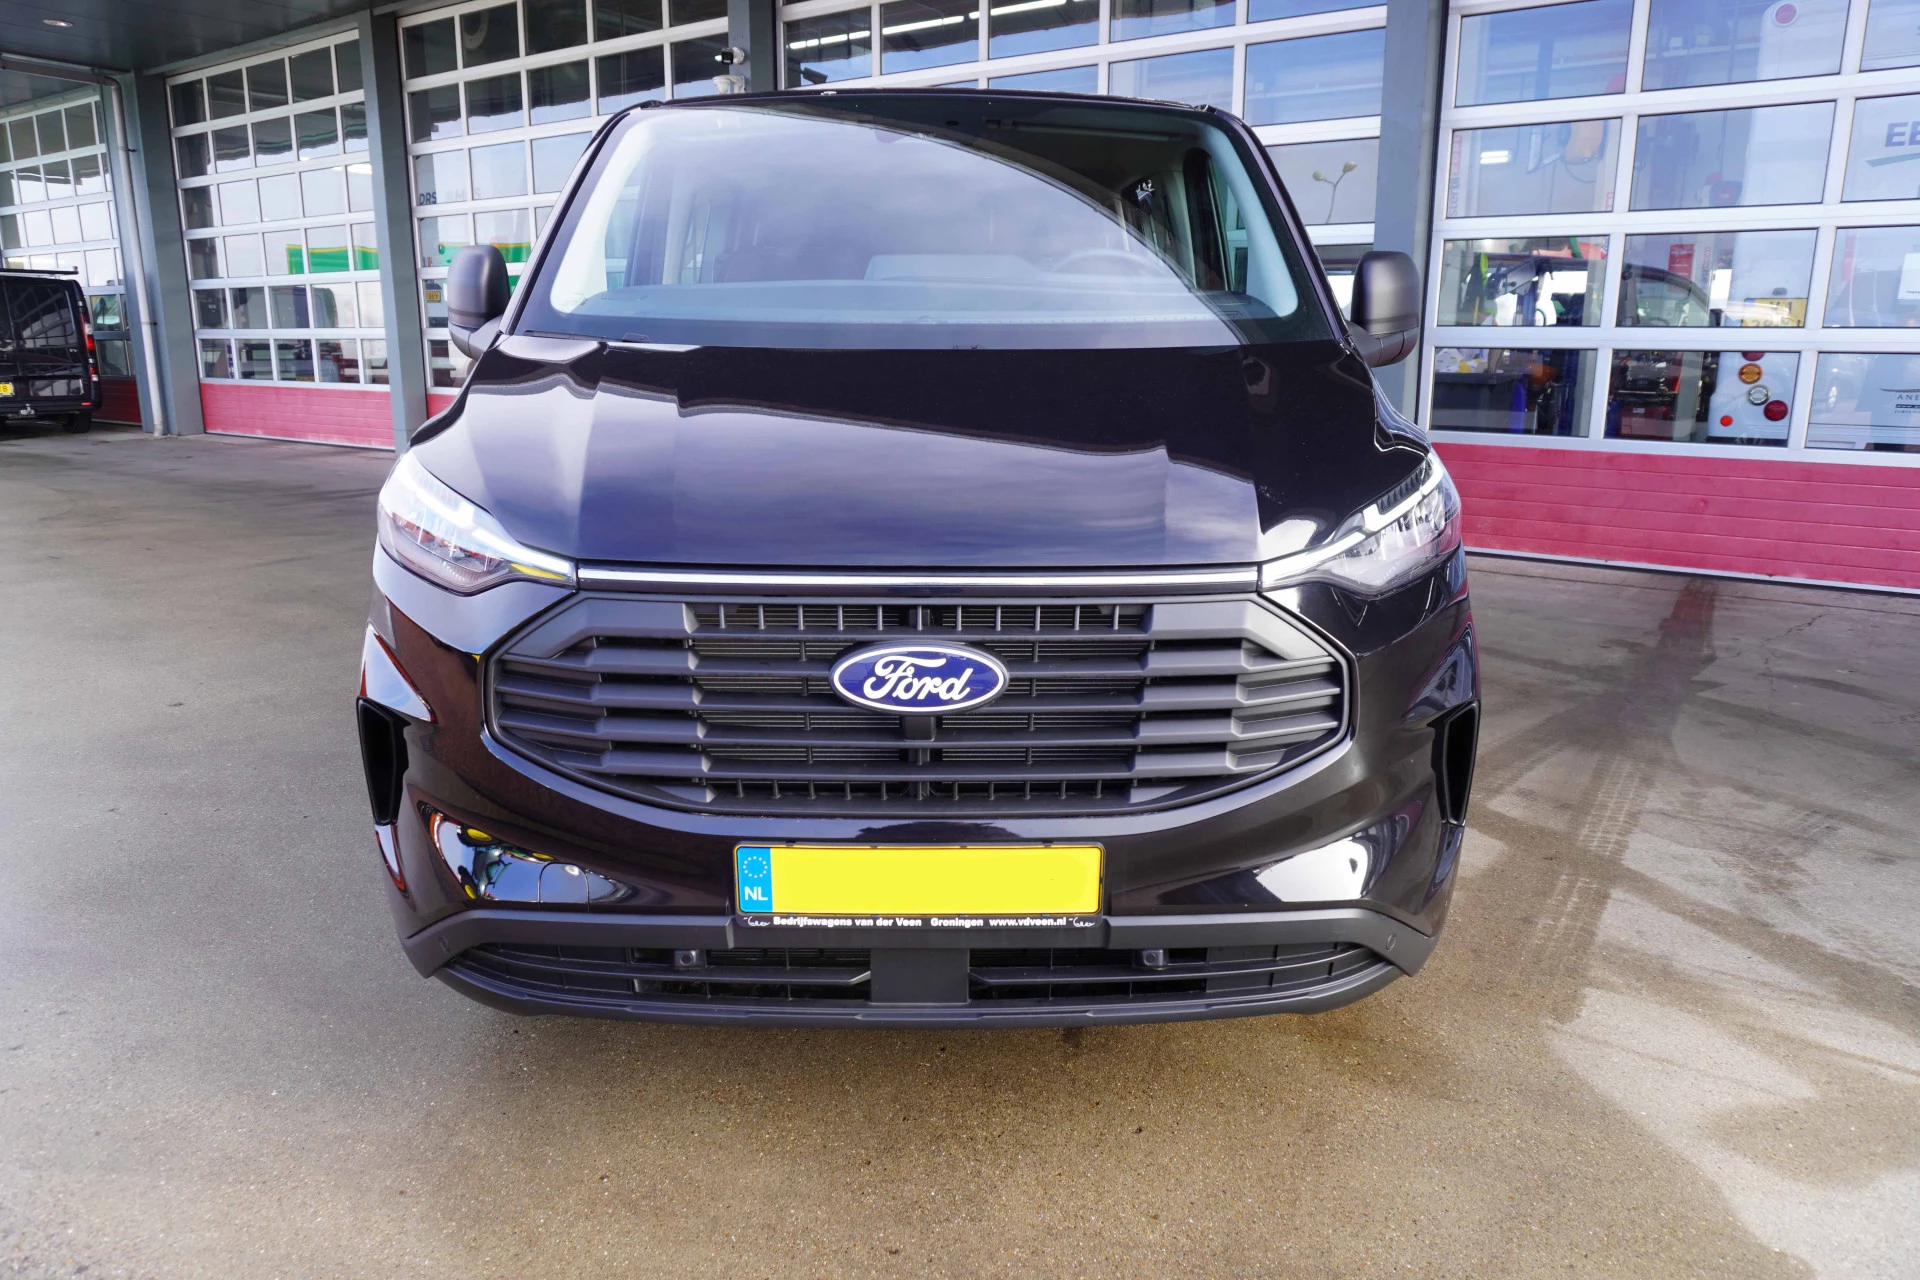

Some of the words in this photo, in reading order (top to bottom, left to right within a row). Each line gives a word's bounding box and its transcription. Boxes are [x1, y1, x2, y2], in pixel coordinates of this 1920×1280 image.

[863, 655, 974, 700] Ford
[744, 886, 768, 901] NL
[773, 916, 852, 928] Bedrijfswagens
[855, 919, 874, 927] van
[876, 917, 894, 927] der
[896, 917, 922, 927] Veen
[930, 917, 984, 928] Groningen
[989, 916, 1067, 927] www.vdveen.nl
